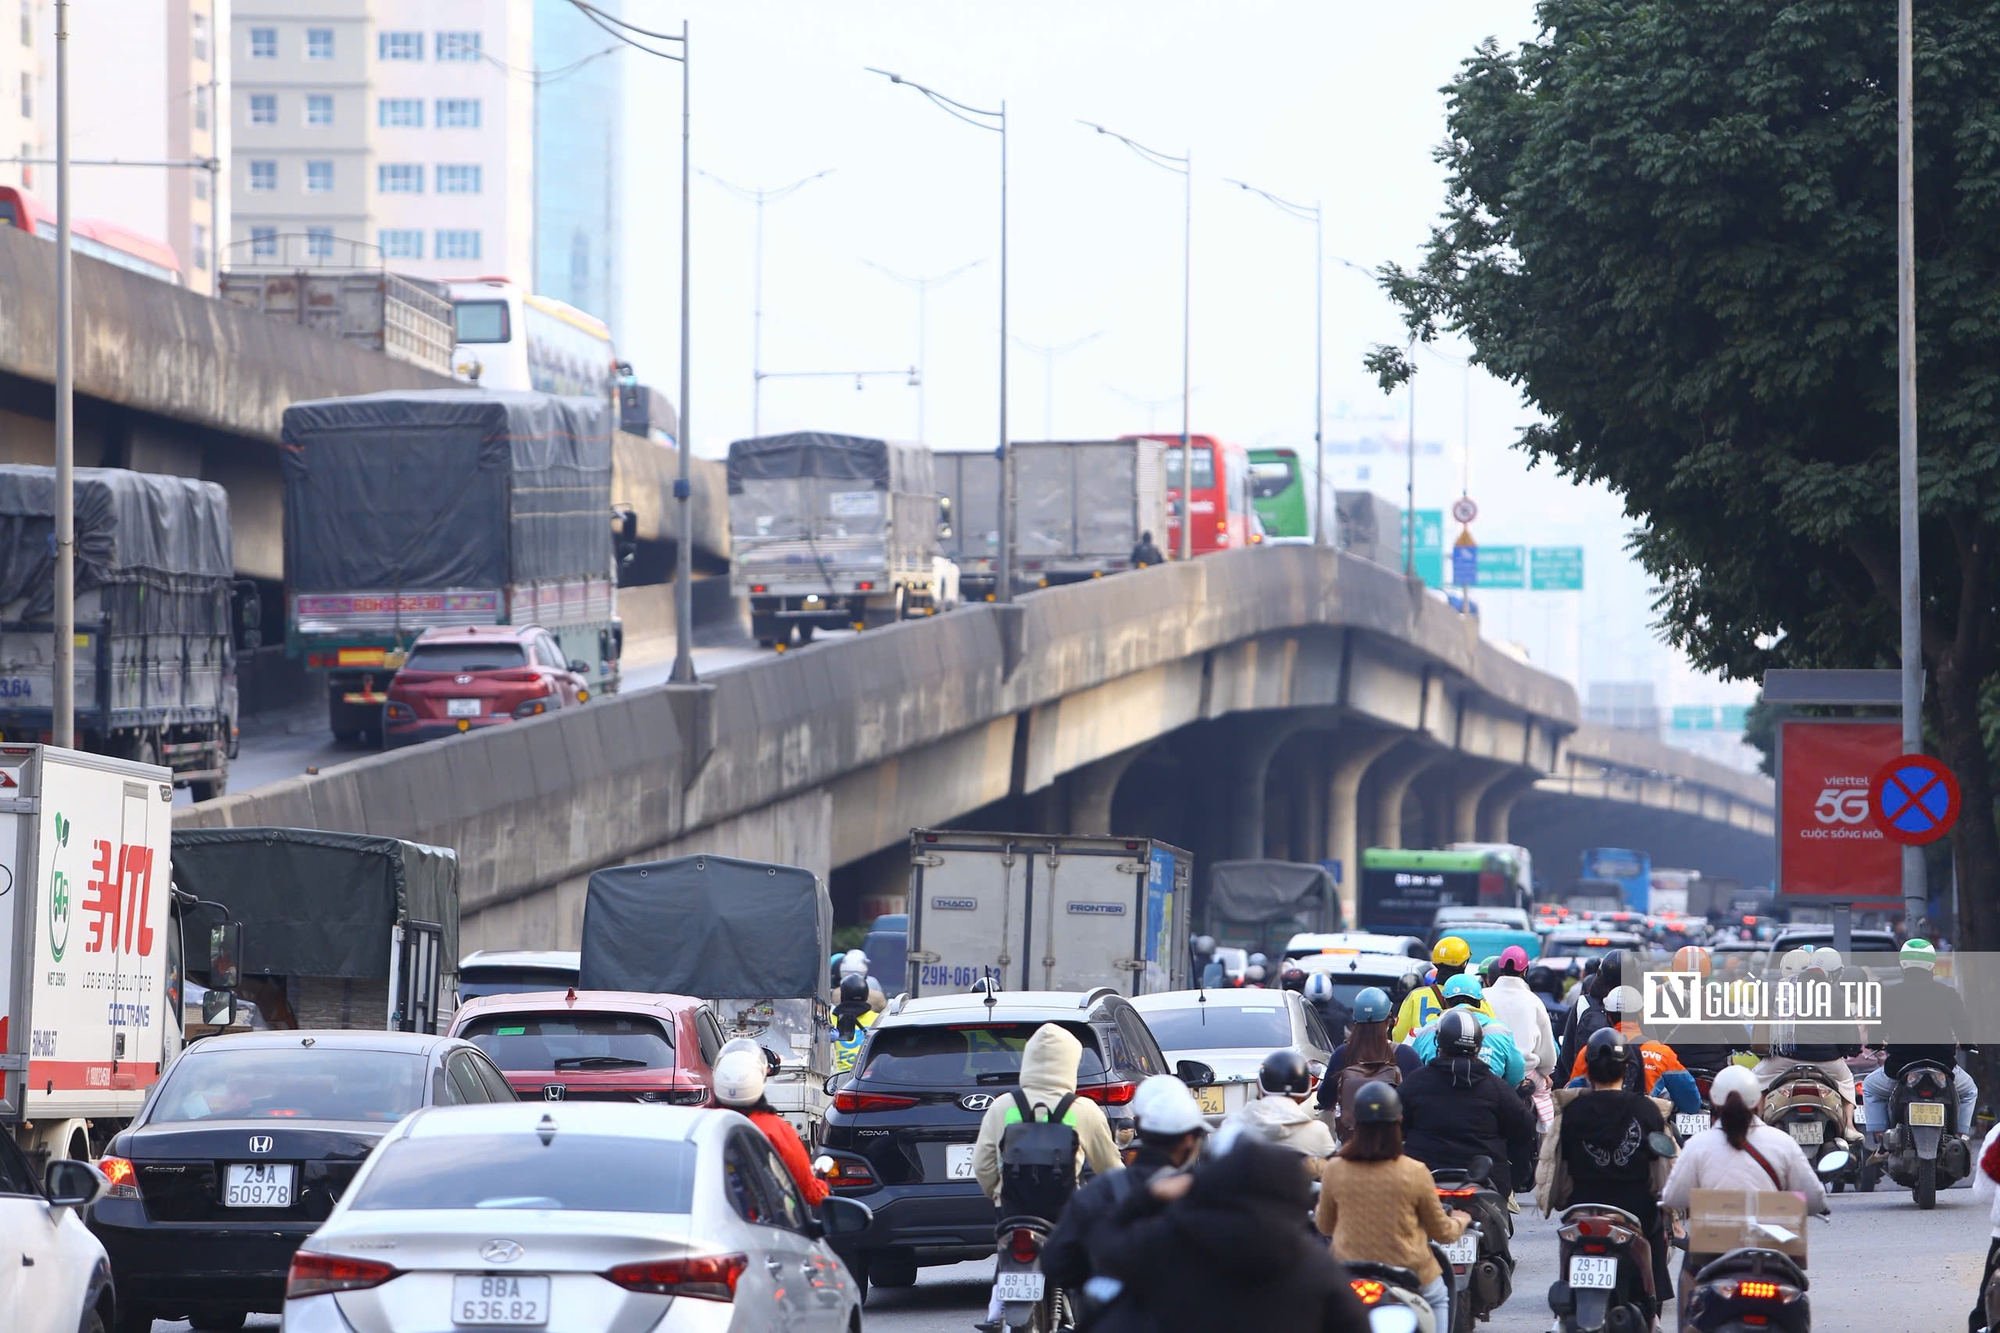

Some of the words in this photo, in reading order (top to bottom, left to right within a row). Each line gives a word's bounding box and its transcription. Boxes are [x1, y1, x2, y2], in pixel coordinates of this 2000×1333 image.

[1824, 776, 1870, 786] viettel
[1814, 788, 1870, 824] 5G
[1801, 827, 1829, 839] CUỘC
[1831, 826, 1861, 839] SỐNG
[936, 899, 974, 908] THACO
[1069, 904, 1124, 914] FRONTIER
[47, 971, 55, 986] NET
[55, 971, 67, 987] ZERO
[82, 971, 115, 989] LOGISTICS
[117, 973, 152, 992] SOLUTIONS
[921, 965, 1001, 987] 29H-0613
[108, 1003, 150, 1027] COOLTRANS
[1202, 1100, 1219, 1113] 24
[1680, 1114, 1706, 1124] 29-G1
[243, 1164, 276, 1184] 29A
[954, 1163, 975, 1177] 47
[228, 1185, 288, 1204] 509.78
[1449, 1249, 1473, 1262] 6.32
[1577, 1258, 1609, 1272] 29-T1
[1004, 1274, 1037, 1287] 89-L1
[1572, 1272, 1613, 1287] 999.20
[480, 1277, 521, 1298] 88A
[462, 1300, 537, 1320] 636.82
